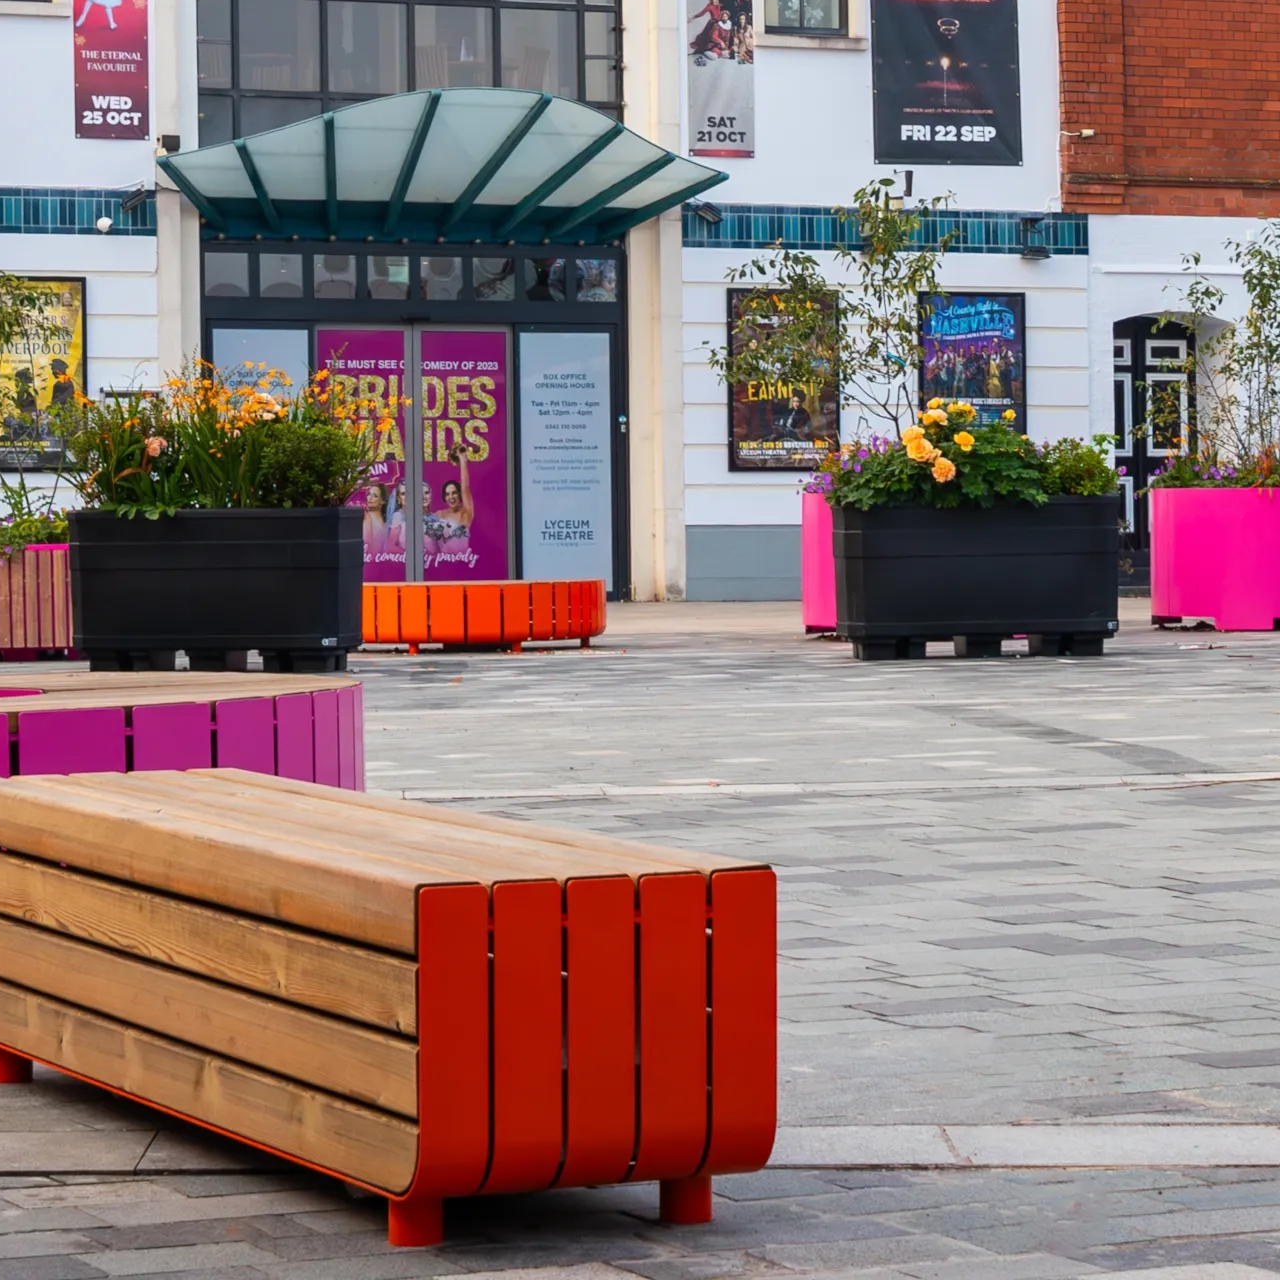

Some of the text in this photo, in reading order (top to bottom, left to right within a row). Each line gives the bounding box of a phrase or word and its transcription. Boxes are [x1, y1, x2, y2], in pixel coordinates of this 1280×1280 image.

[80, 49, 143, 61] THE ETERNAL
[87, 62, 137, 72] FAVOURITE
[91, 95, 133, 110] WED
[82, 110, 142, 126] 25 OCT
[707, 116, 736, 128] SAT
[696, 130, 747, 143] 21 OCT
[900, 124, 997, 142] FRI 22 SEP
[930, 312, 1015, 340] NASHVILLE
[325, 359, 346, 369] THE
[347, 359, 376, 369] MUST
[377, 360, 398, 369] SEE
[461, 362, 476, 370] OF
[477, 362, 499, 370] 2023
[560, 373, 587, 381] OFFICE
[544, 519, 590, 530] LYCEUM
[540, 530, 594, 541] THEATRE
[434, 547, 479, 569] parody
